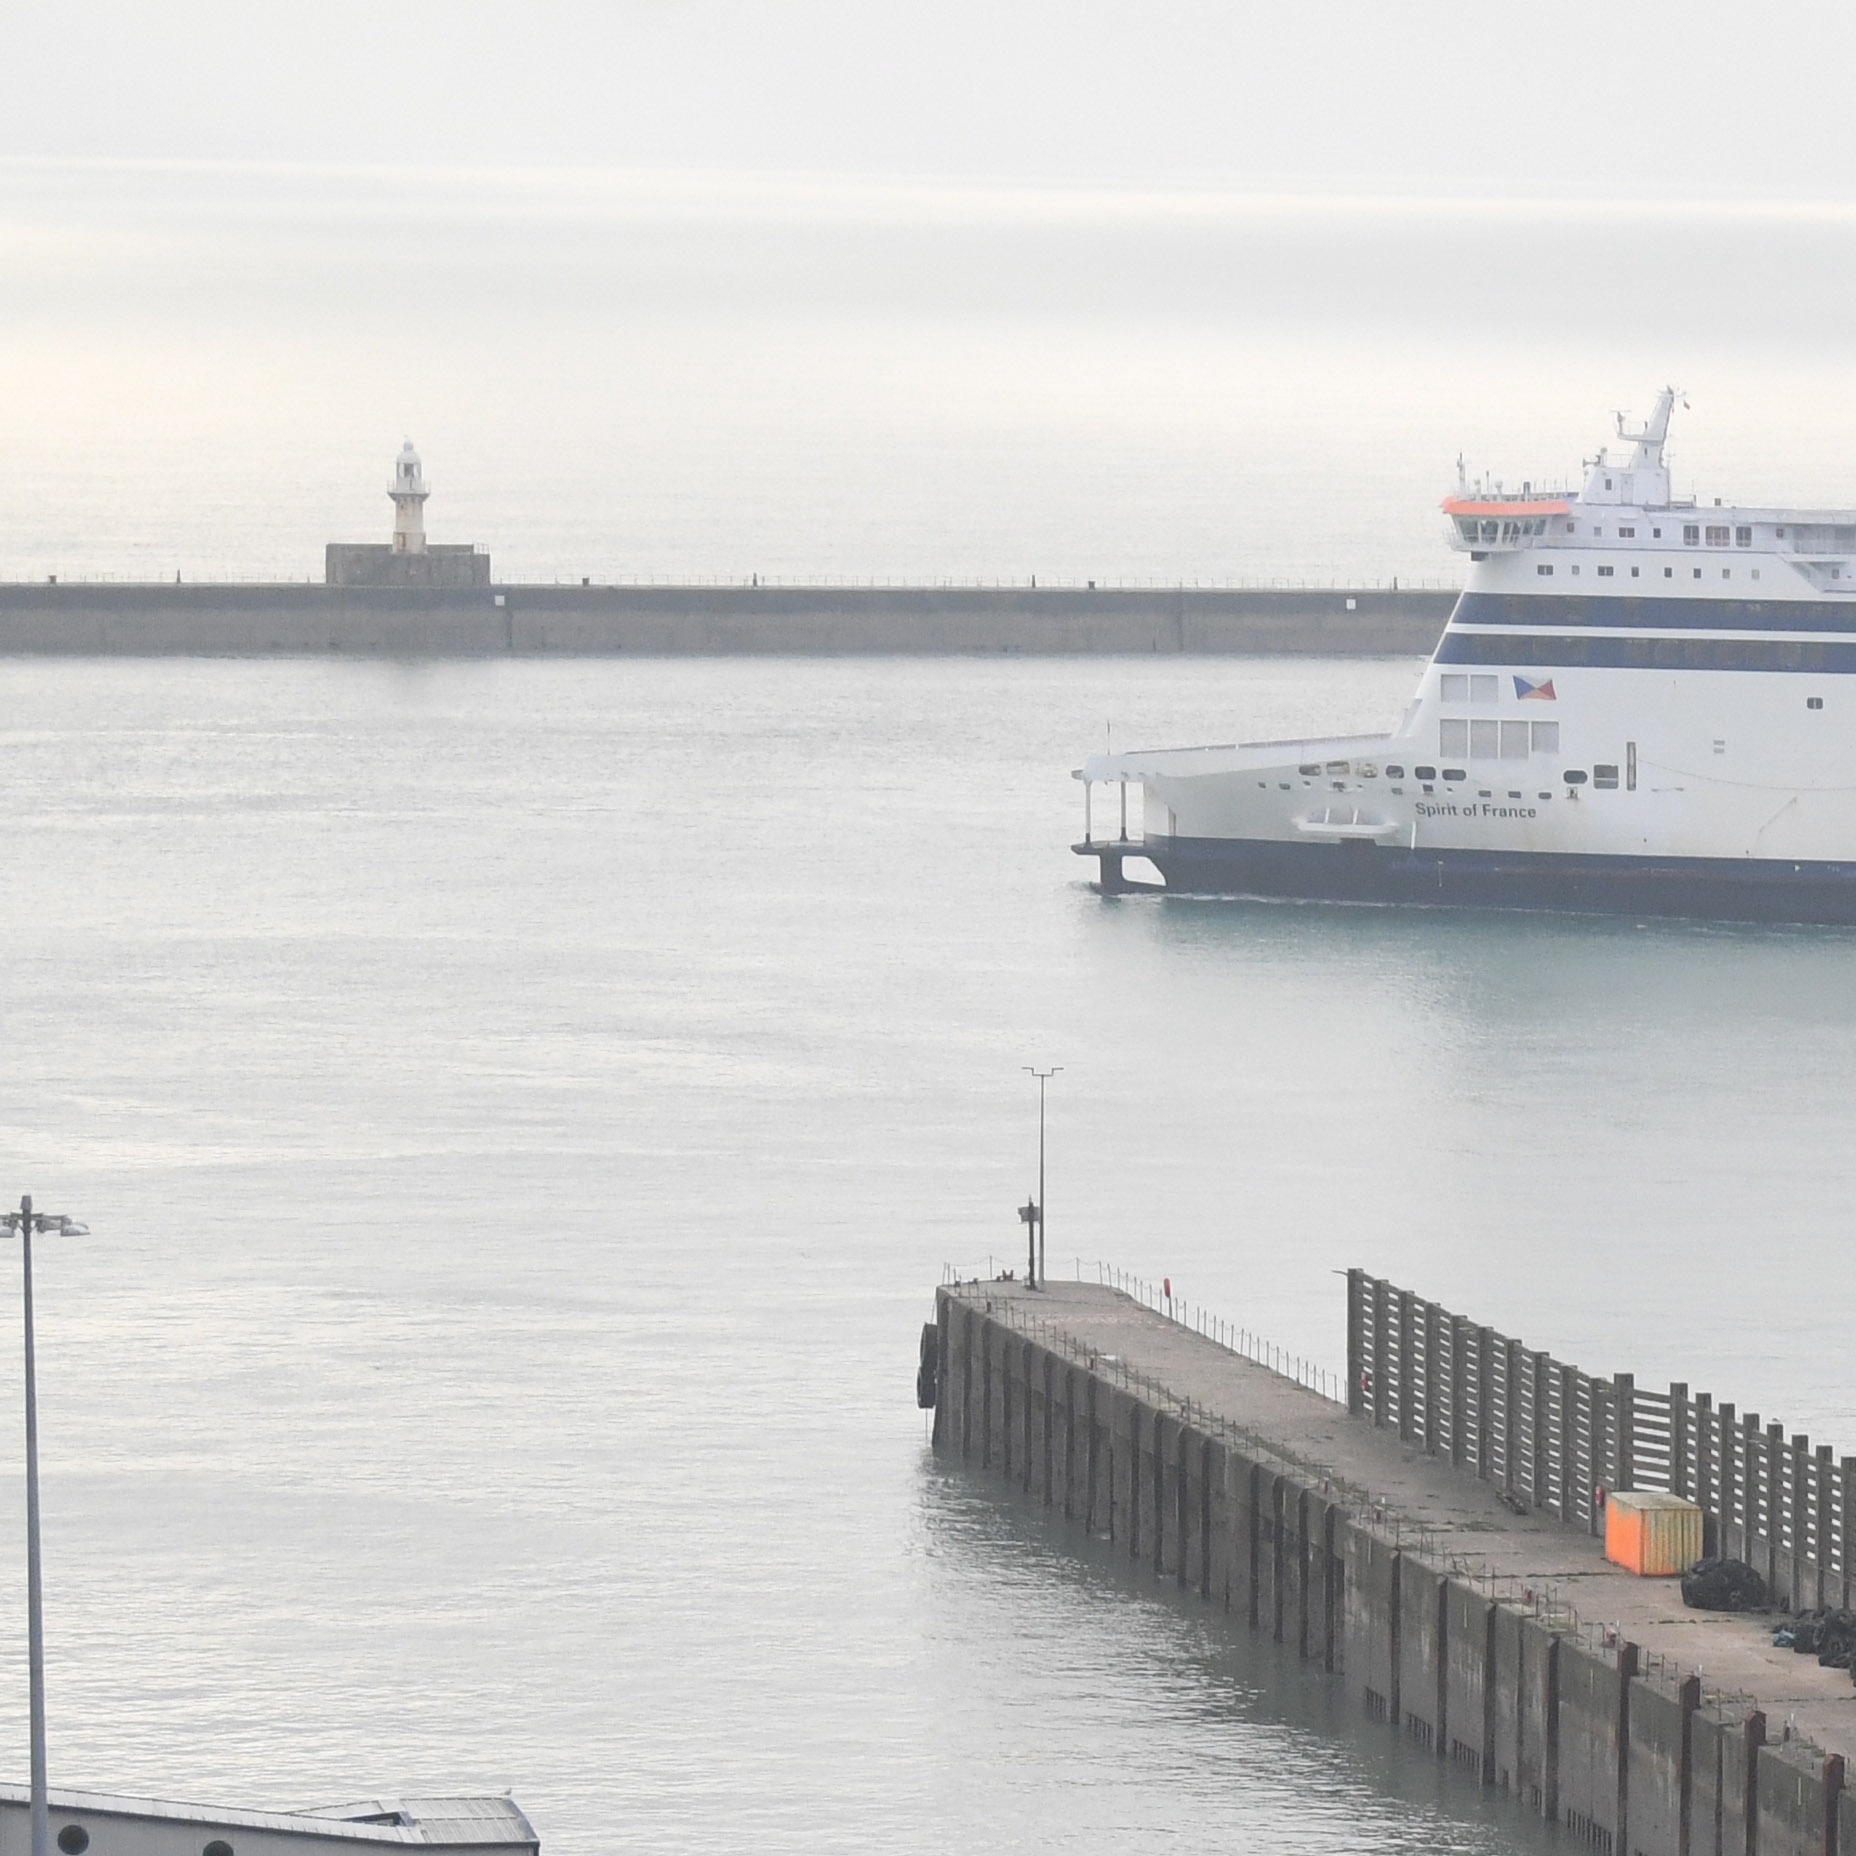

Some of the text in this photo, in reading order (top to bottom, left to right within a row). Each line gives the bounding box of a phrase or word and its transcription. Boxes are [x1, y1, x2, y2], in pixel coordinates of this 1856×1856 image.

[1415, 802, 1537, 818] Spirit of France
